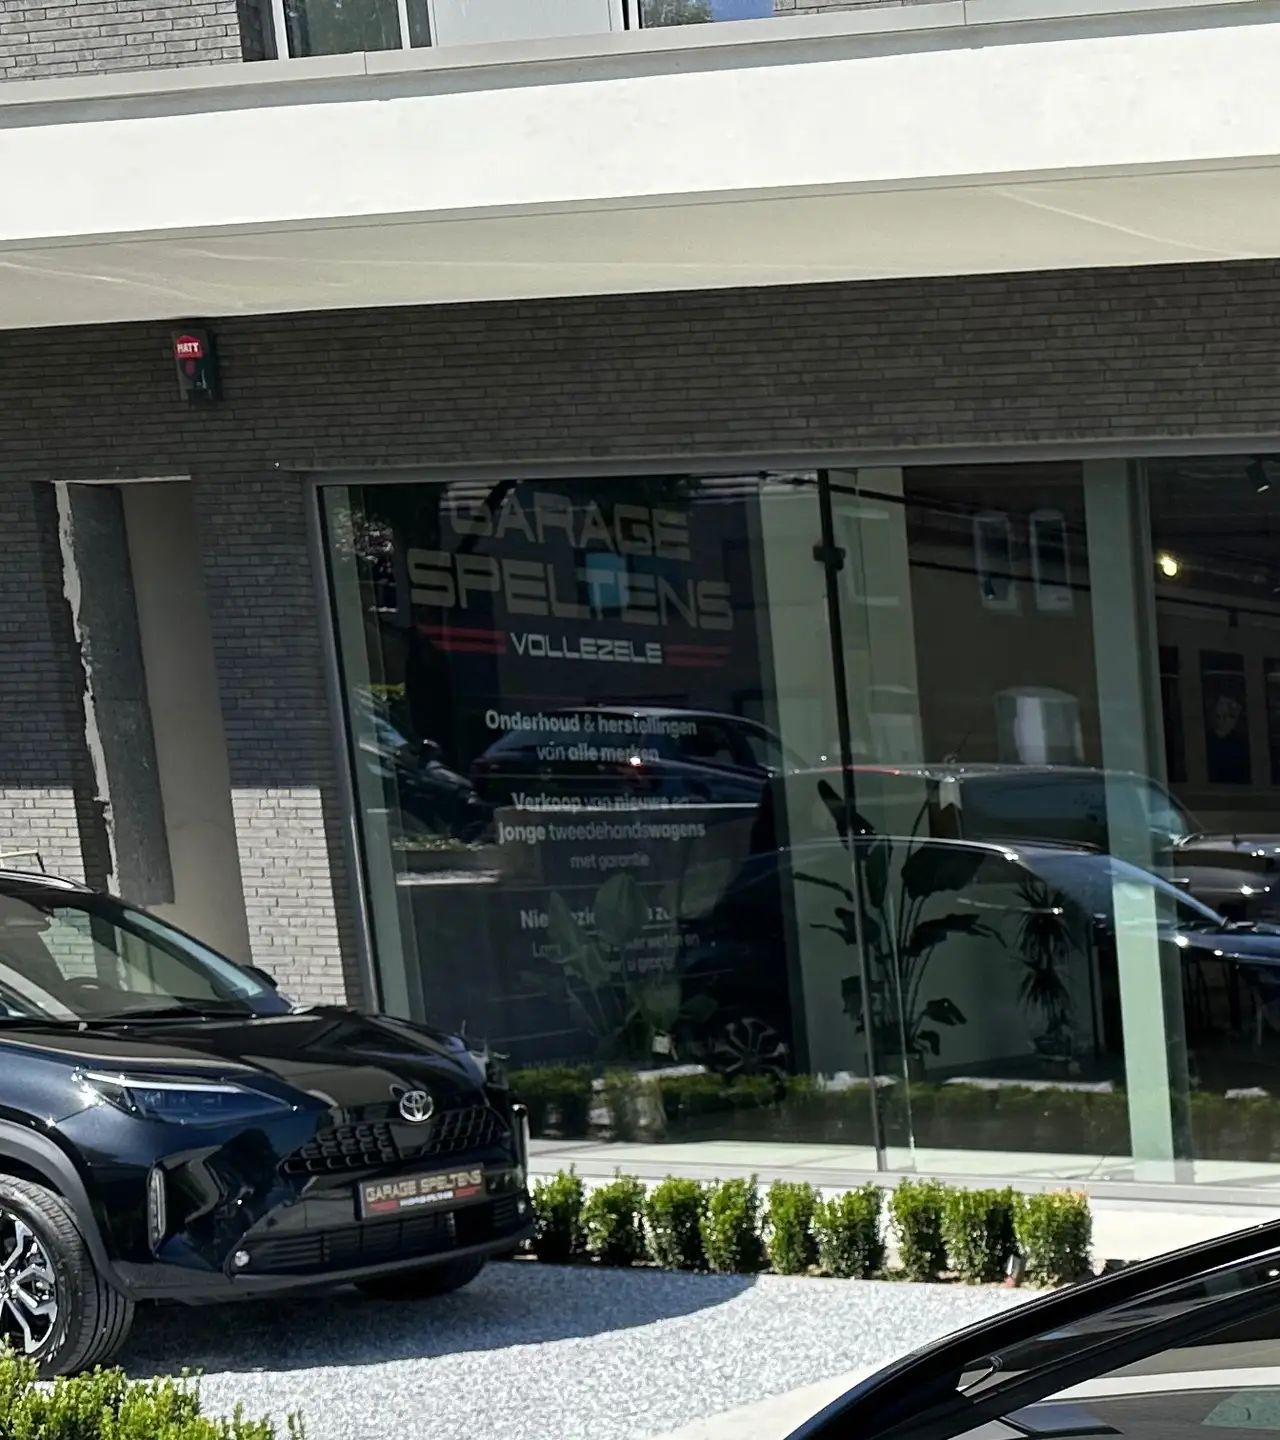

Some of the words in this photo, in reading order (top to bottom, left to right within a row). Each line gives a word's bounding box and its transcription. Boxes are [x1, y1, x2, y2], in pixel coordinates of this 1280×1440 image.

[446, 485, 691, 561] GARAGE
[406, 547, 734, 631] SPELTENS
[509, 632, 663, 664] VOLLEZELE
[485, 708, 580, 732] Onderhoud
[584, 713, 596, 732] &
[598, 713, 697, 739] herstellingen
[536, 745, 566, 761] van
[567, 742, 599, 761] alle
[600, 743, 660, 762] merken
[511, 791, 582, 813] Verkoop
[498, 820, 546, 846] jonge
[548, 819, 706, 842] tweedehandswagens
[571, 855, 597, 869] met
[598, 852, 651, 872] garantie
[366, 1180, 416, 1203] GARAGE
[420, 1169, 482, 1193] SPELTENS
